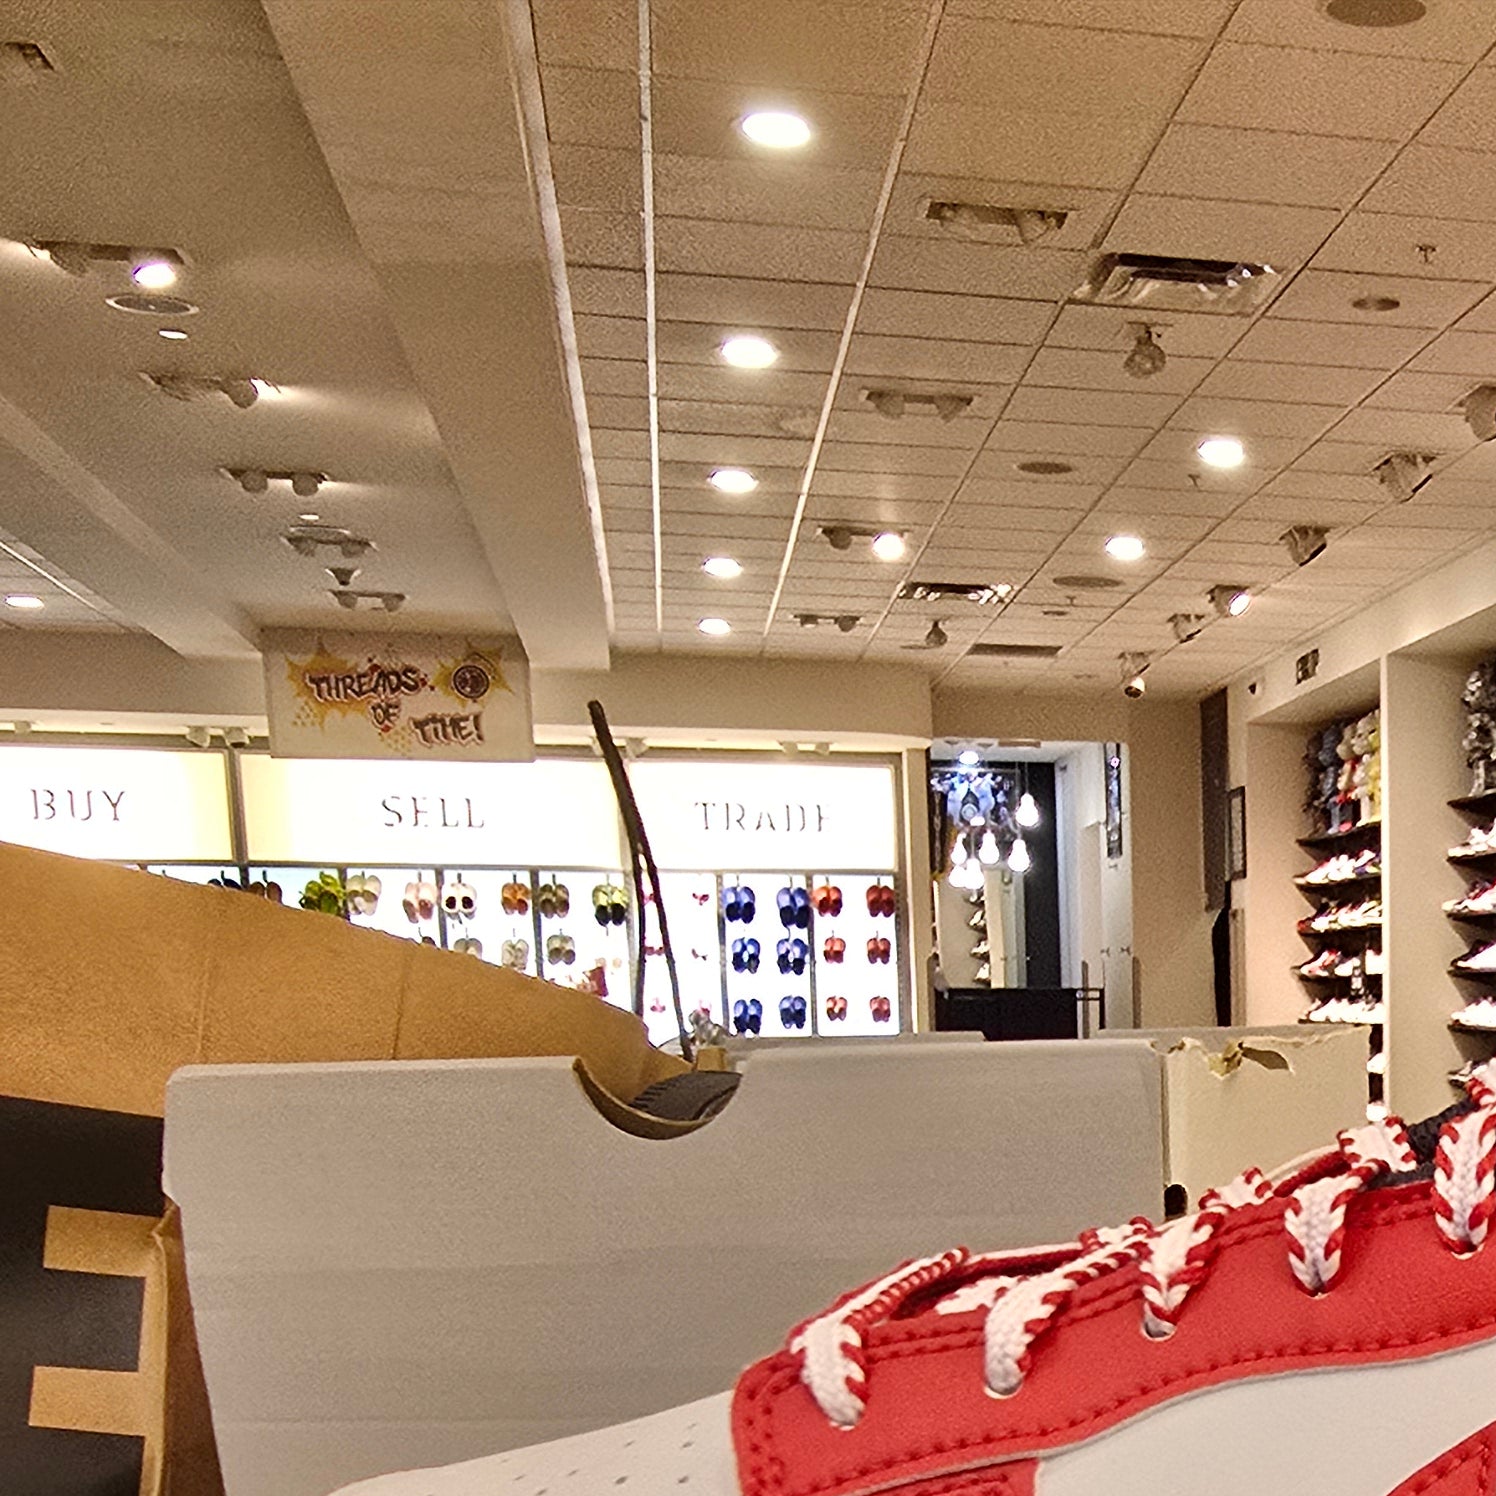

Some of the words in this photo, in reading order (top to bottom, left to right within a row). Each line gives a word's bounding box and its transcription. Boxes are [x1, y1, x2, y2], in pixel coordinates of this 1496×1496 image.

[306, 666, 420, 701] THREADS
[371, 702, 400, 727] OF
[30, 788, 126, 821] BUY
[381, 795, 485, 828] SELL
[694, 801, 831, 832] TRADE
